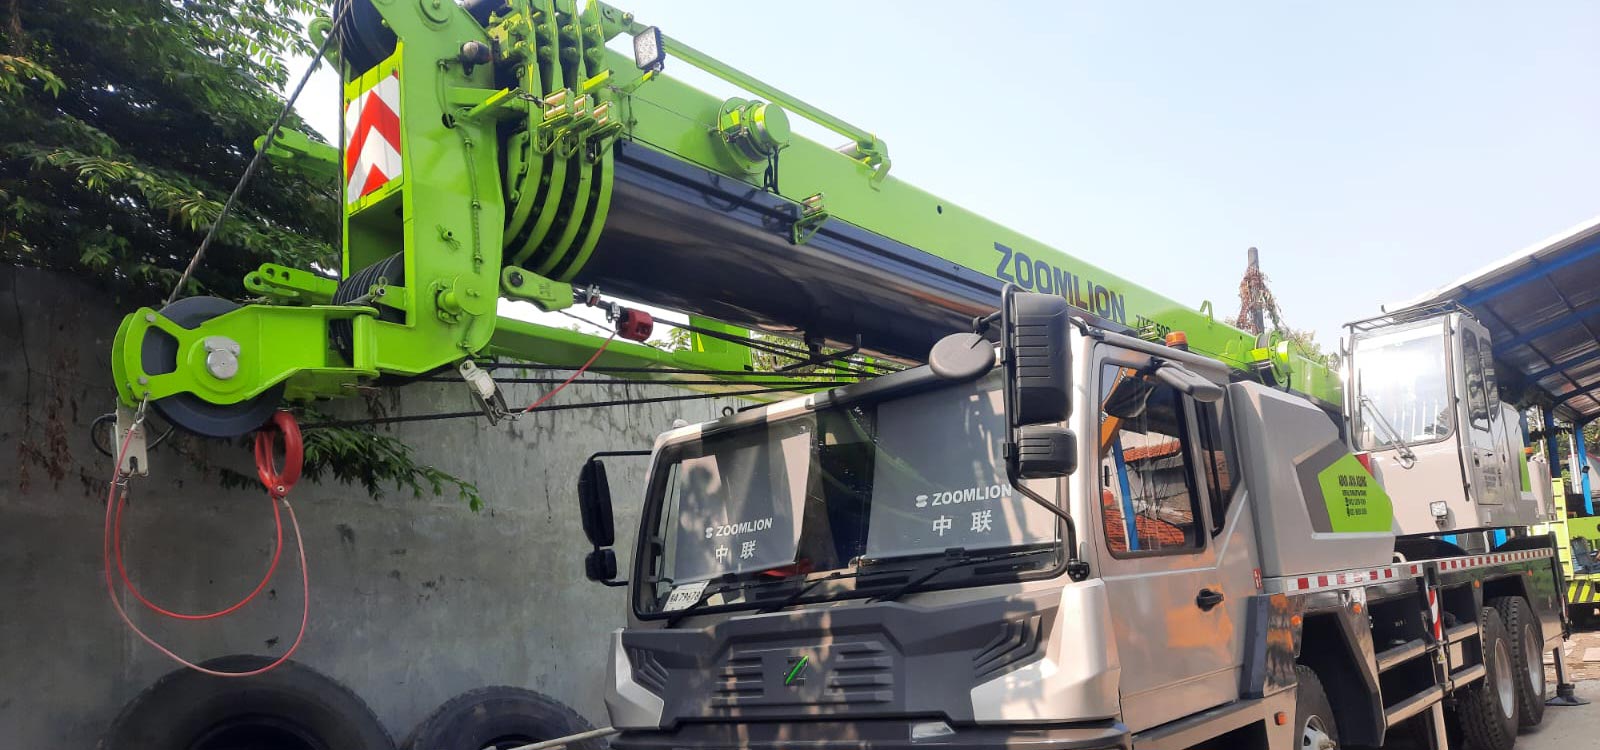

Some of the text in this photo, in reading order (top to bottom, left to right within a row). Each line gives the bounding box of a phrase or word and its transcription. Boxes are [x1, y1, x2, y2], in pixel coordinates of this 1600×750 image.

[993, 241, 1126, 326] ZOOMLION
[931, 484, 1012, 506] ZOOMLION
[716, 517, 773, 537] ZOOMLION
